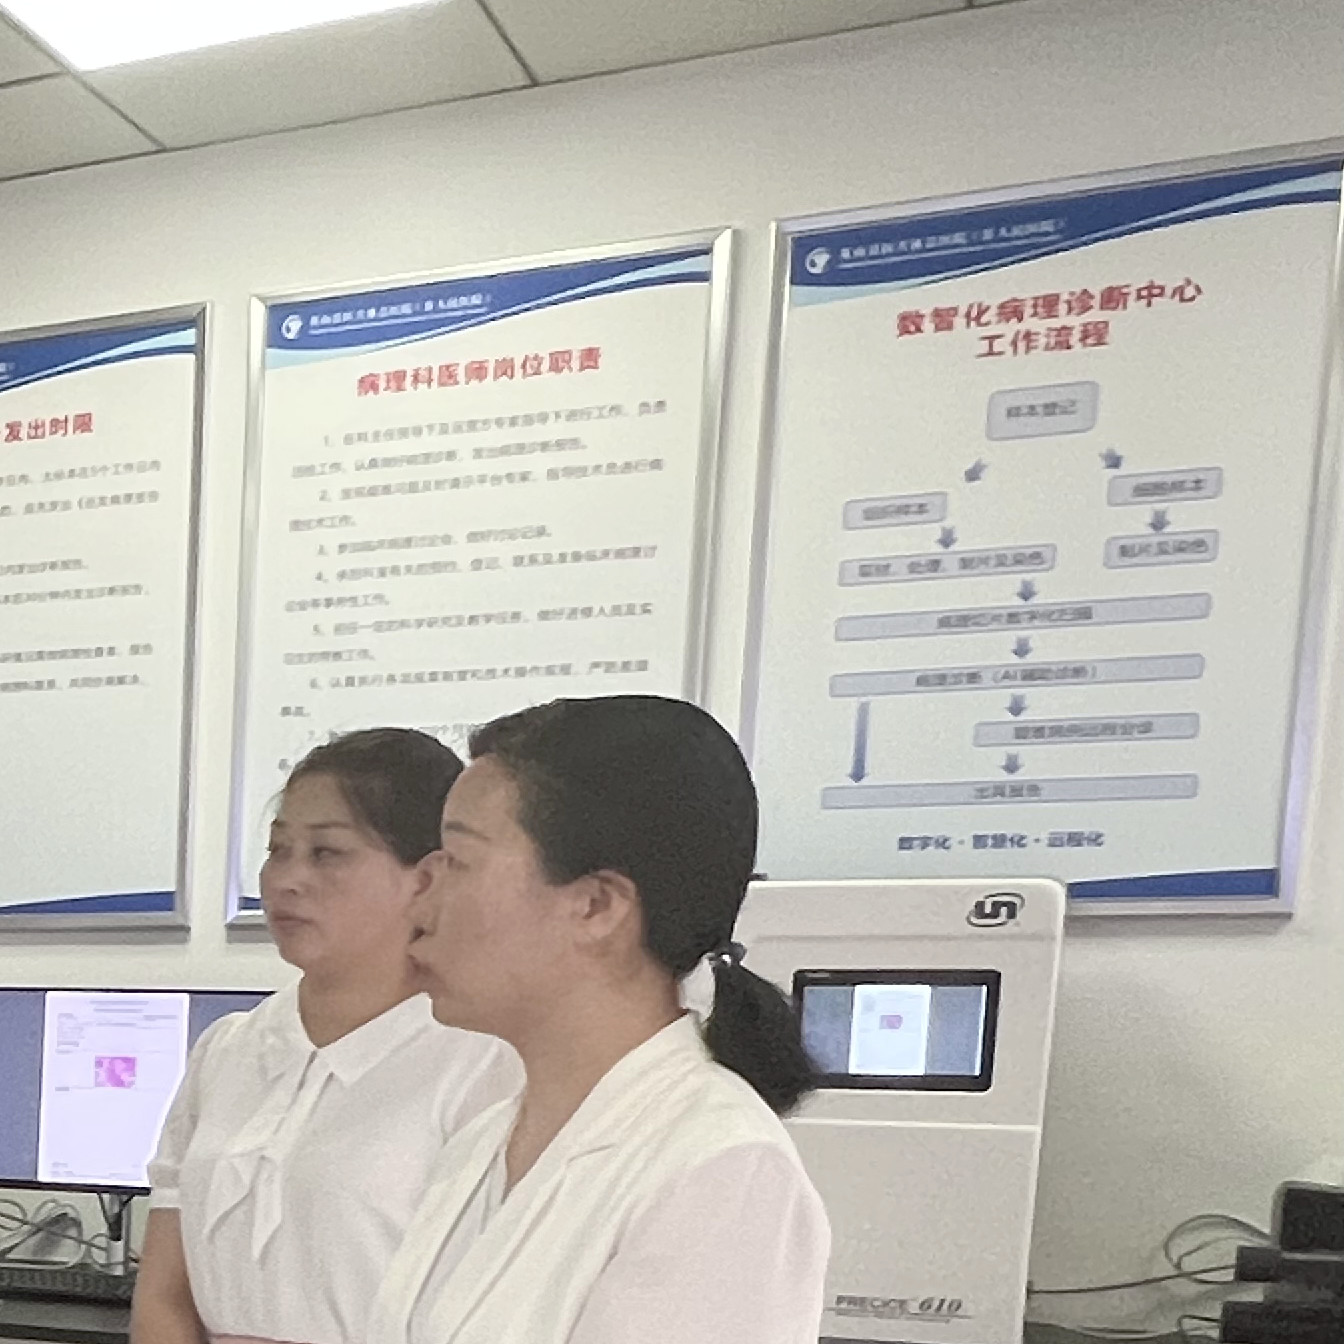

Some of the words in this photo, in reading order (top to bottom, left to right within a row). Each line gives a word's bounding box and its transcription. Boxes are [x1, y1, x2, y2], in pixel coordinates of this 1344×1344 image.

[896, 277, 1203, 338] 数智化病理诊断中心
[976, 320, 1110, 359] 工作流程
[357, 346, 602, 397] 病理科医师岗位职责
[918, 1297, 963, 1314] 610
